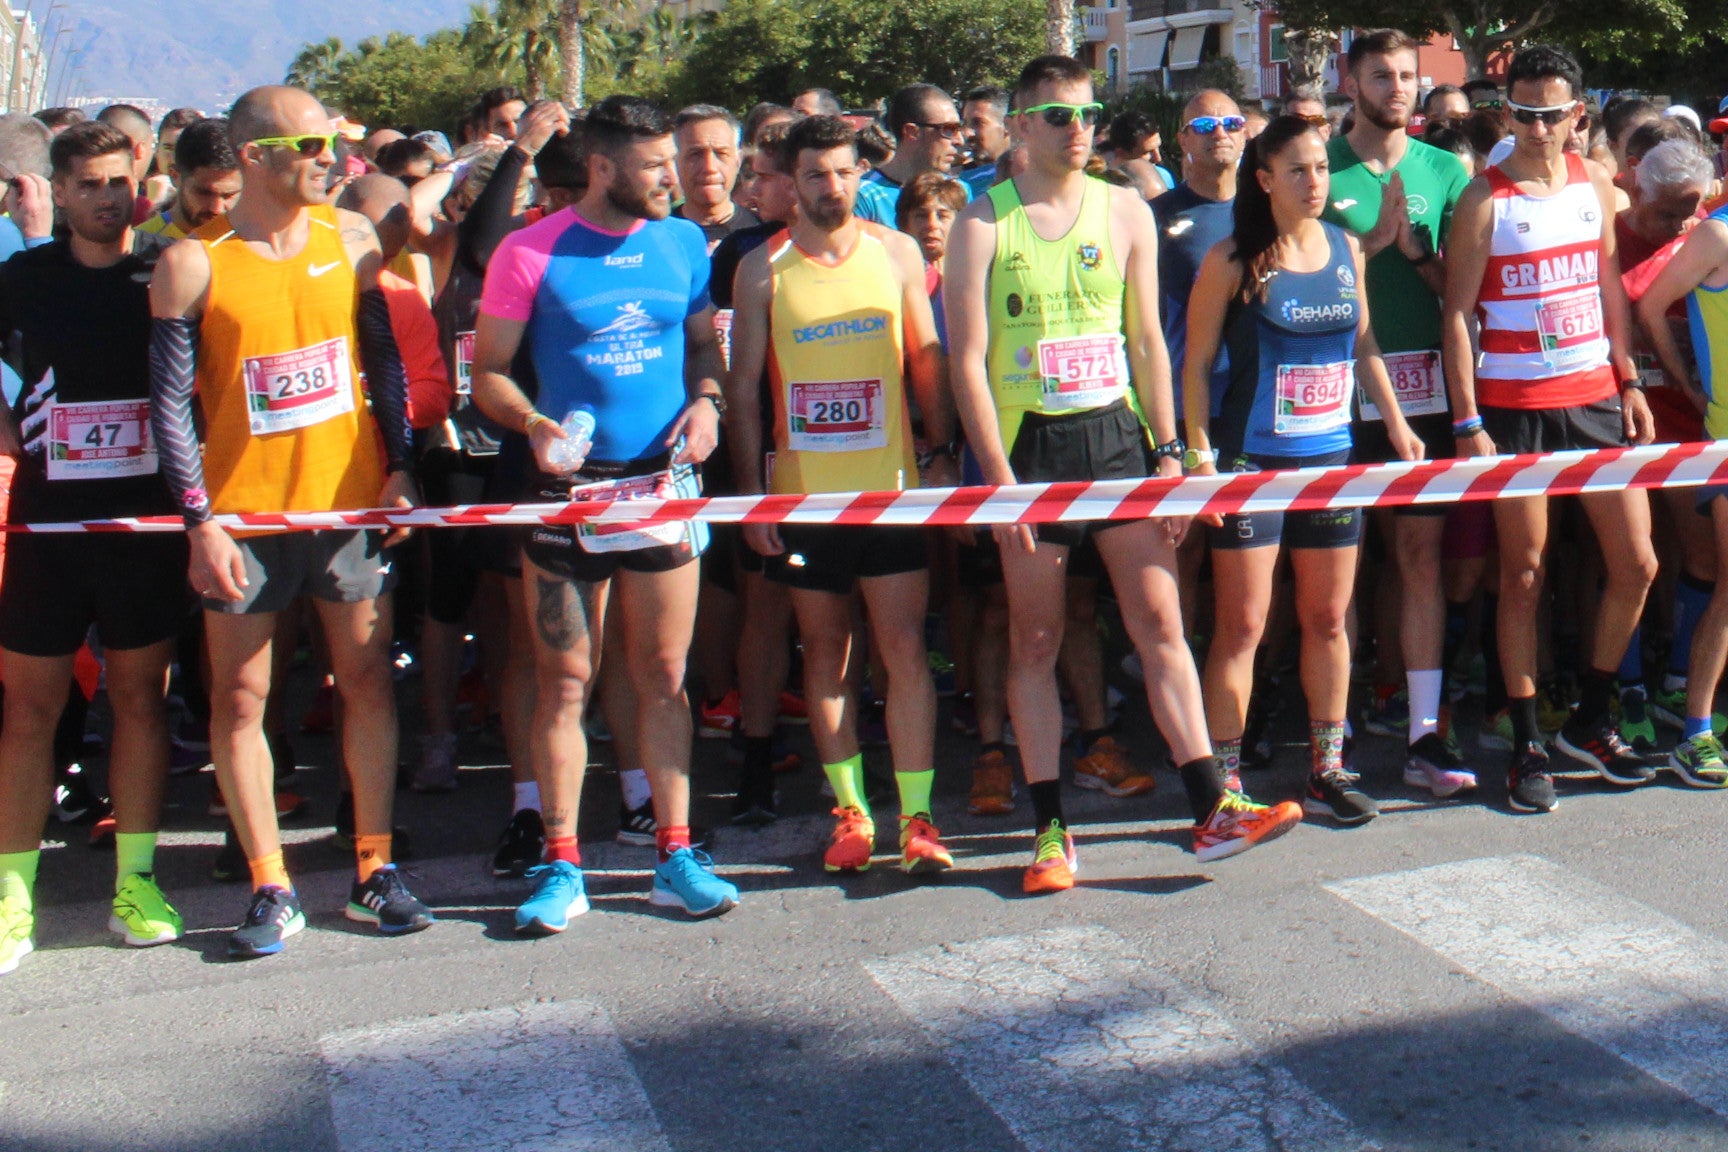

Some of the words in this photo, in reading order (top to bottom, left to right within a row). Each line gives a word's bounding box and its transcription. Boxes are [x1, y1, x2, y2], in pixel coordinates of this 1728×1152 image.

[1501, 248, 1598, 288] GRANAD
[1291, 303, 1353, 320] DEHARO
[1562, 311, 1596, 336] 673
[793, 316, 887, 344] DECATHLON
[586, 346, 663, 365] MARATON
[1067, 355, 1109, 379] 572
[276, 366, 326, 398] 238
[1303, 384, 1338, 404] 694
[814, 400, 860, 422] 280
[85, 423, 122, 448] 47
